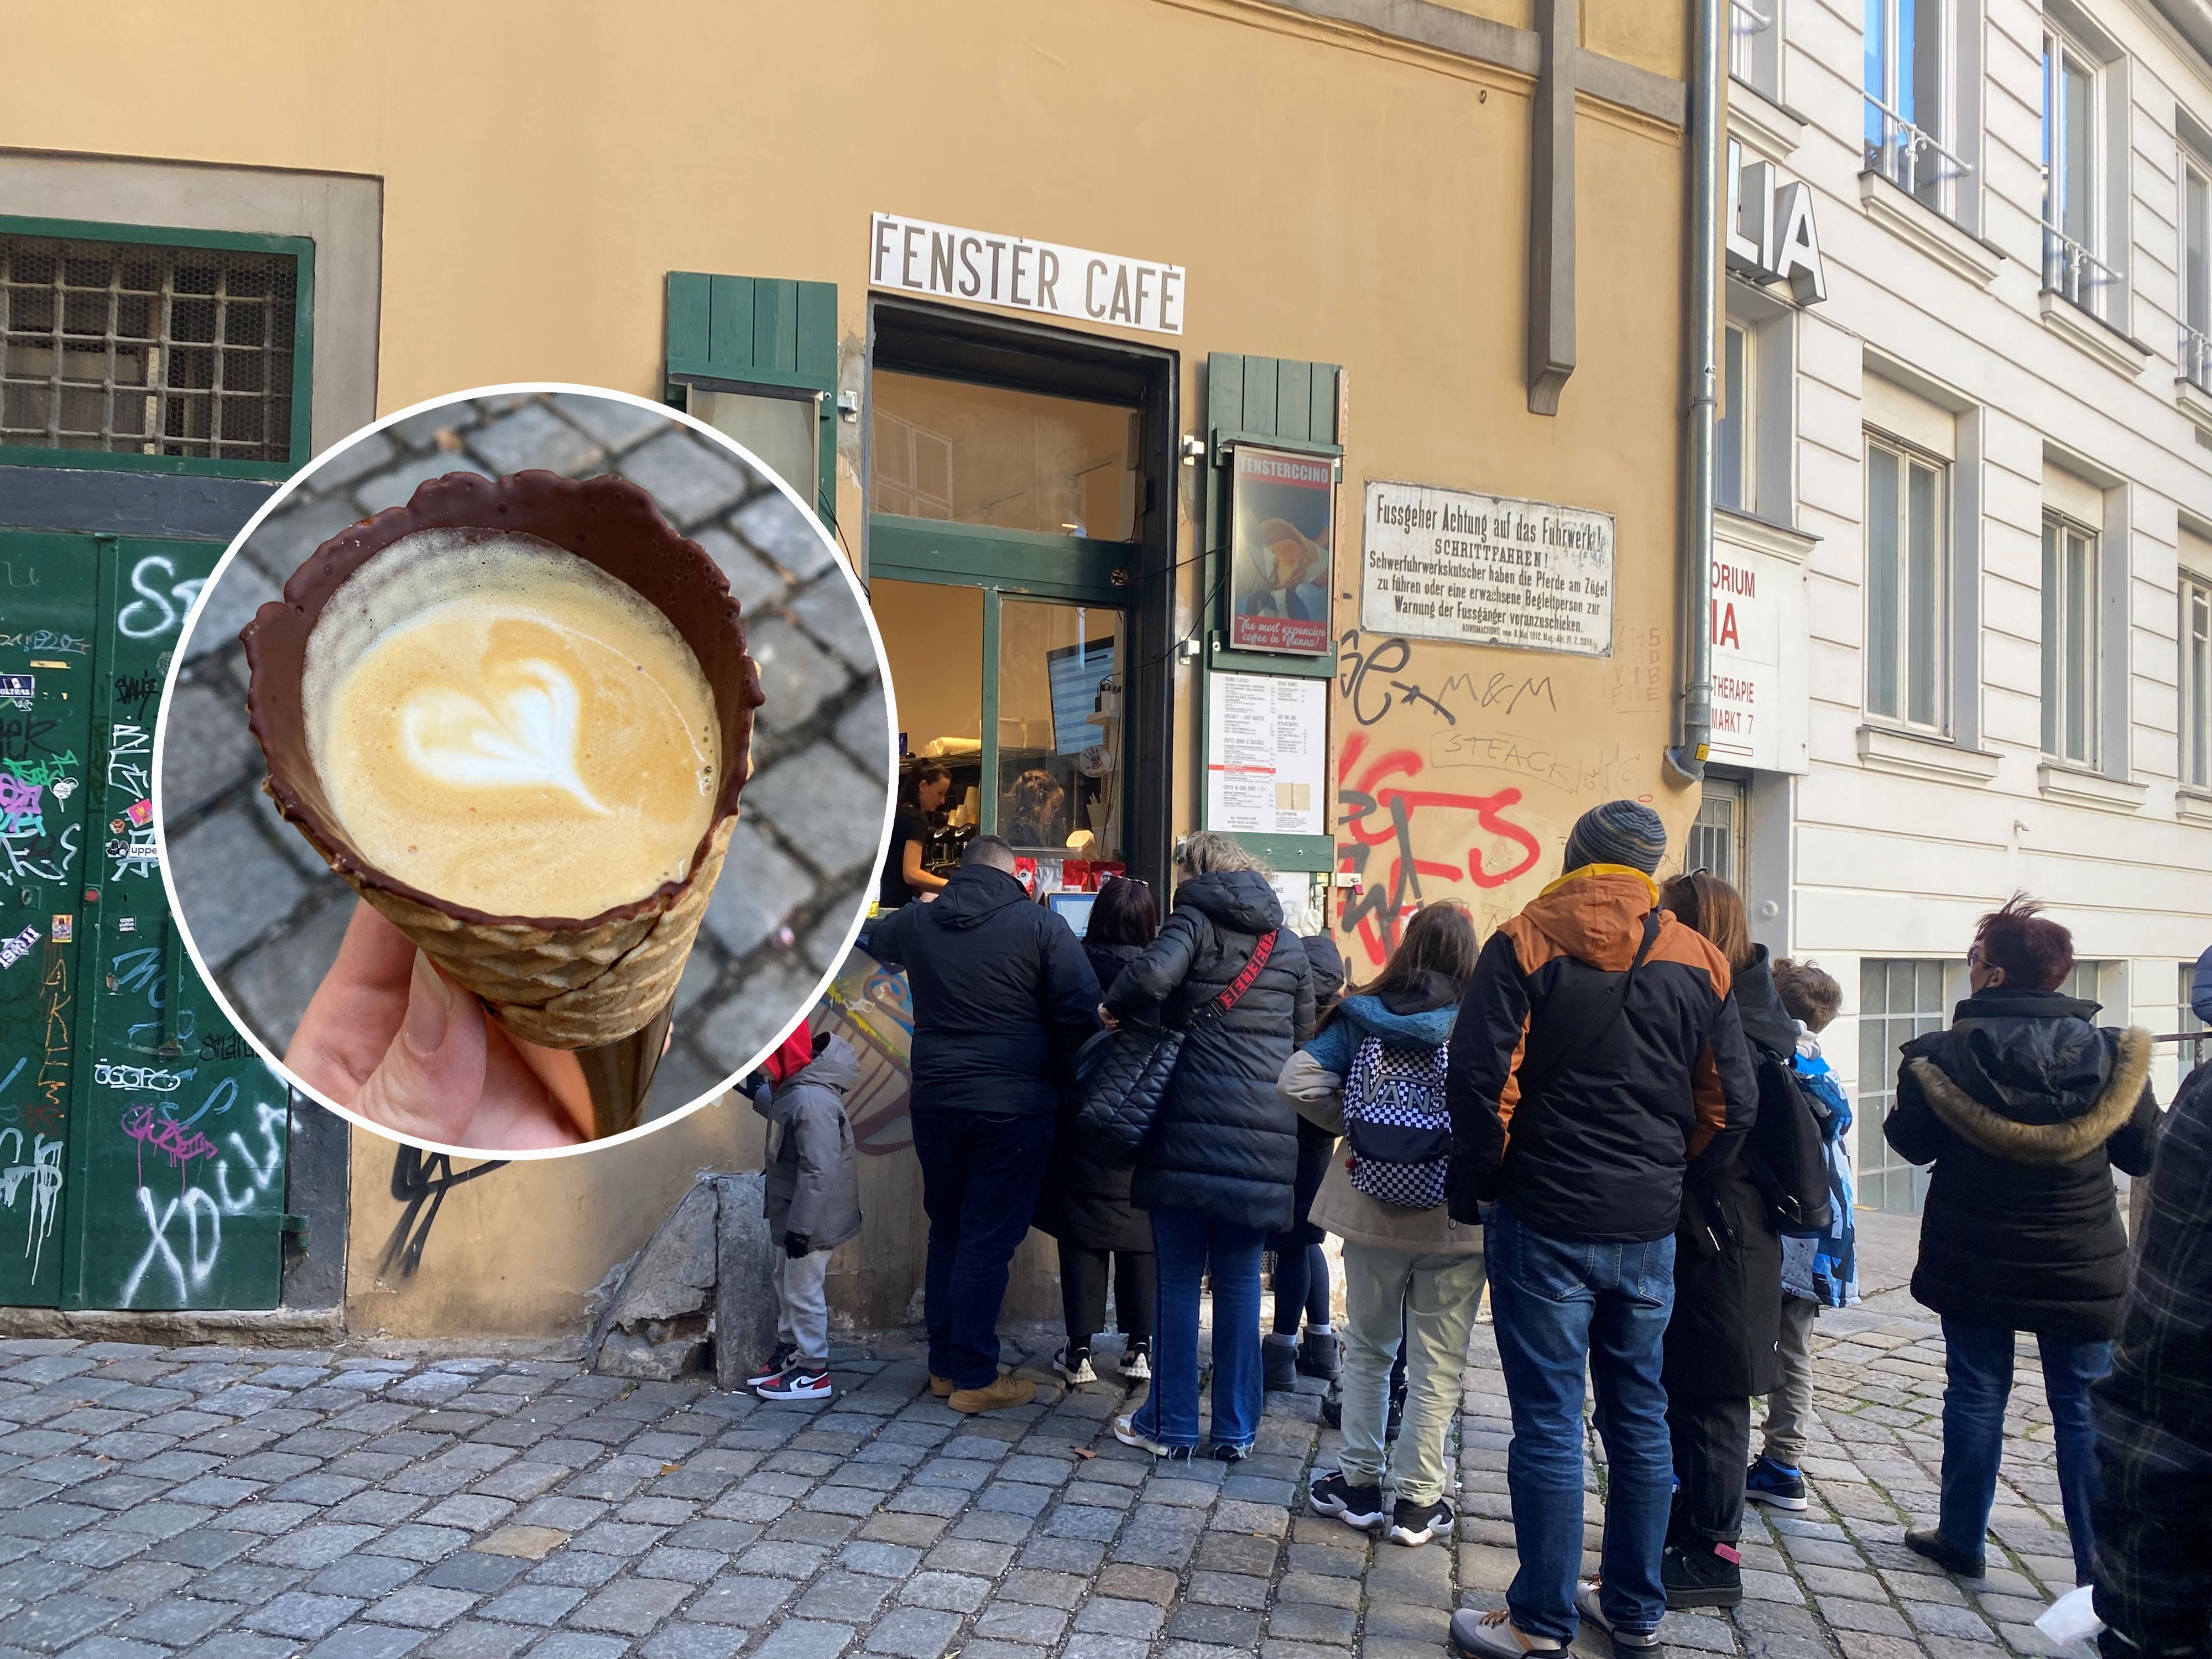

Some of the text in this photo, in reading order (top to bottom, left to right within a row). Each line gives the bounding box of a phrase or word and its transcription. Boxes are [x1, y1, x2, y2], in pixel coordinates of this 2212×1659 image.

[874, 220, 1181, 330] FENSTER CAFE
[1241, 457, 1328, 483] FENSTERCCINO
[1377, 494, 1437, 534] Fussgeher
[1442, 503, 1487, 543] Achtung
[1494, 512, 1511, 540] auf
[1517, 514, 1536, 542] das
[1370, 551, 1608, 598] Schwerfuhrwerkskutscher haben die Pferde am Zügel
[1378, 575, 1600, 615] zu führen oder eine erwachsene Begleitperson zur
[1395, 595, 1583, 633] Warnung der Fussgänger voranzuschicken.
[1238, 617, 1256, 633] The
[1259, 622, 1280, 633] most
[1243, 633, 1319, 647] coffee in Vienna!
[1713, 675, 1754, 703] THERAPIE
[1712, 708, 1754, 735] MARKT 7
[1363, 1066, 1447, 1114] VANS
